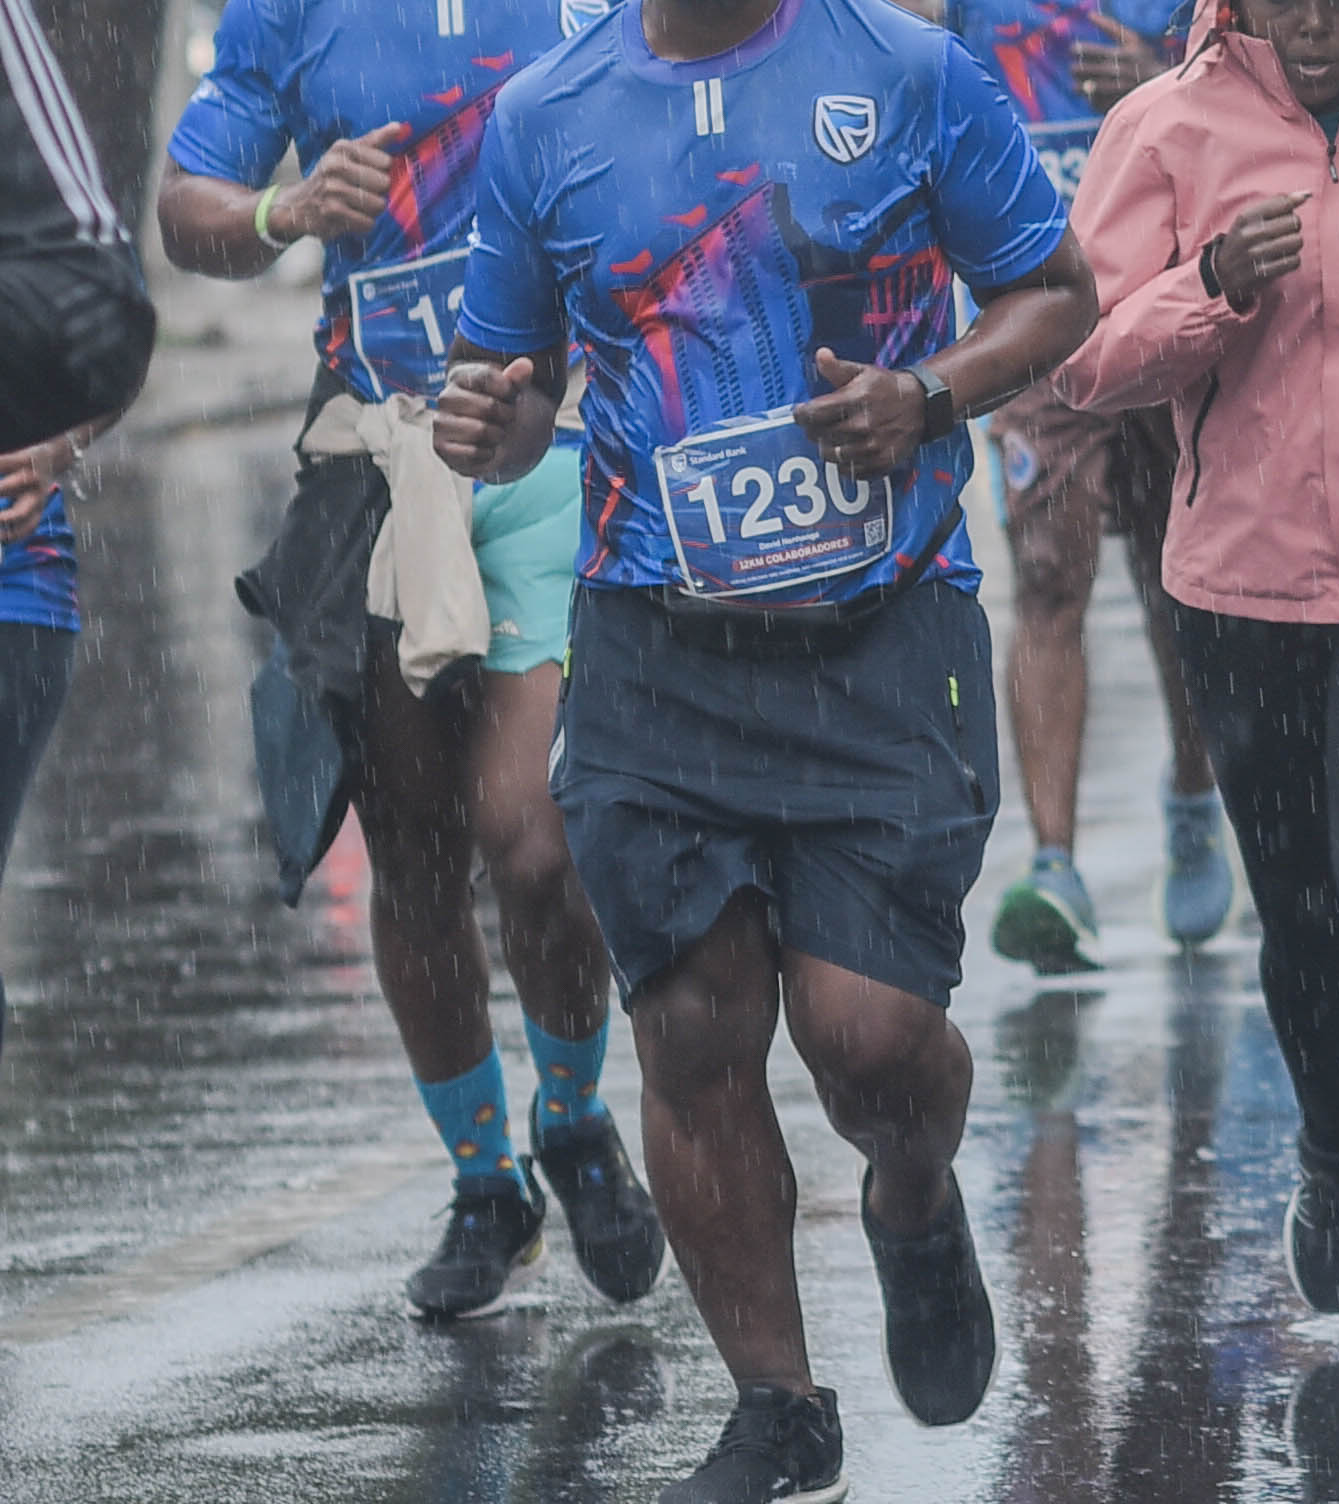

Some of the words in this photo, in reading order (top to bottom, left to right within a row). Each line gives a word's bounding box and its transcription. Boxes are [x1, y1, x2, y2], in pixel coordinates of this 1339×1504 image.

[408, 285, 465, 355] 1
[690, 450, 725, 465] Standard
[726, 447, 747, 458] Bank
[687, 456, 870, 544] 1230
[739, 555, 765, 571] 12KM
[765, 537, 850, 565] COLABORADORES
